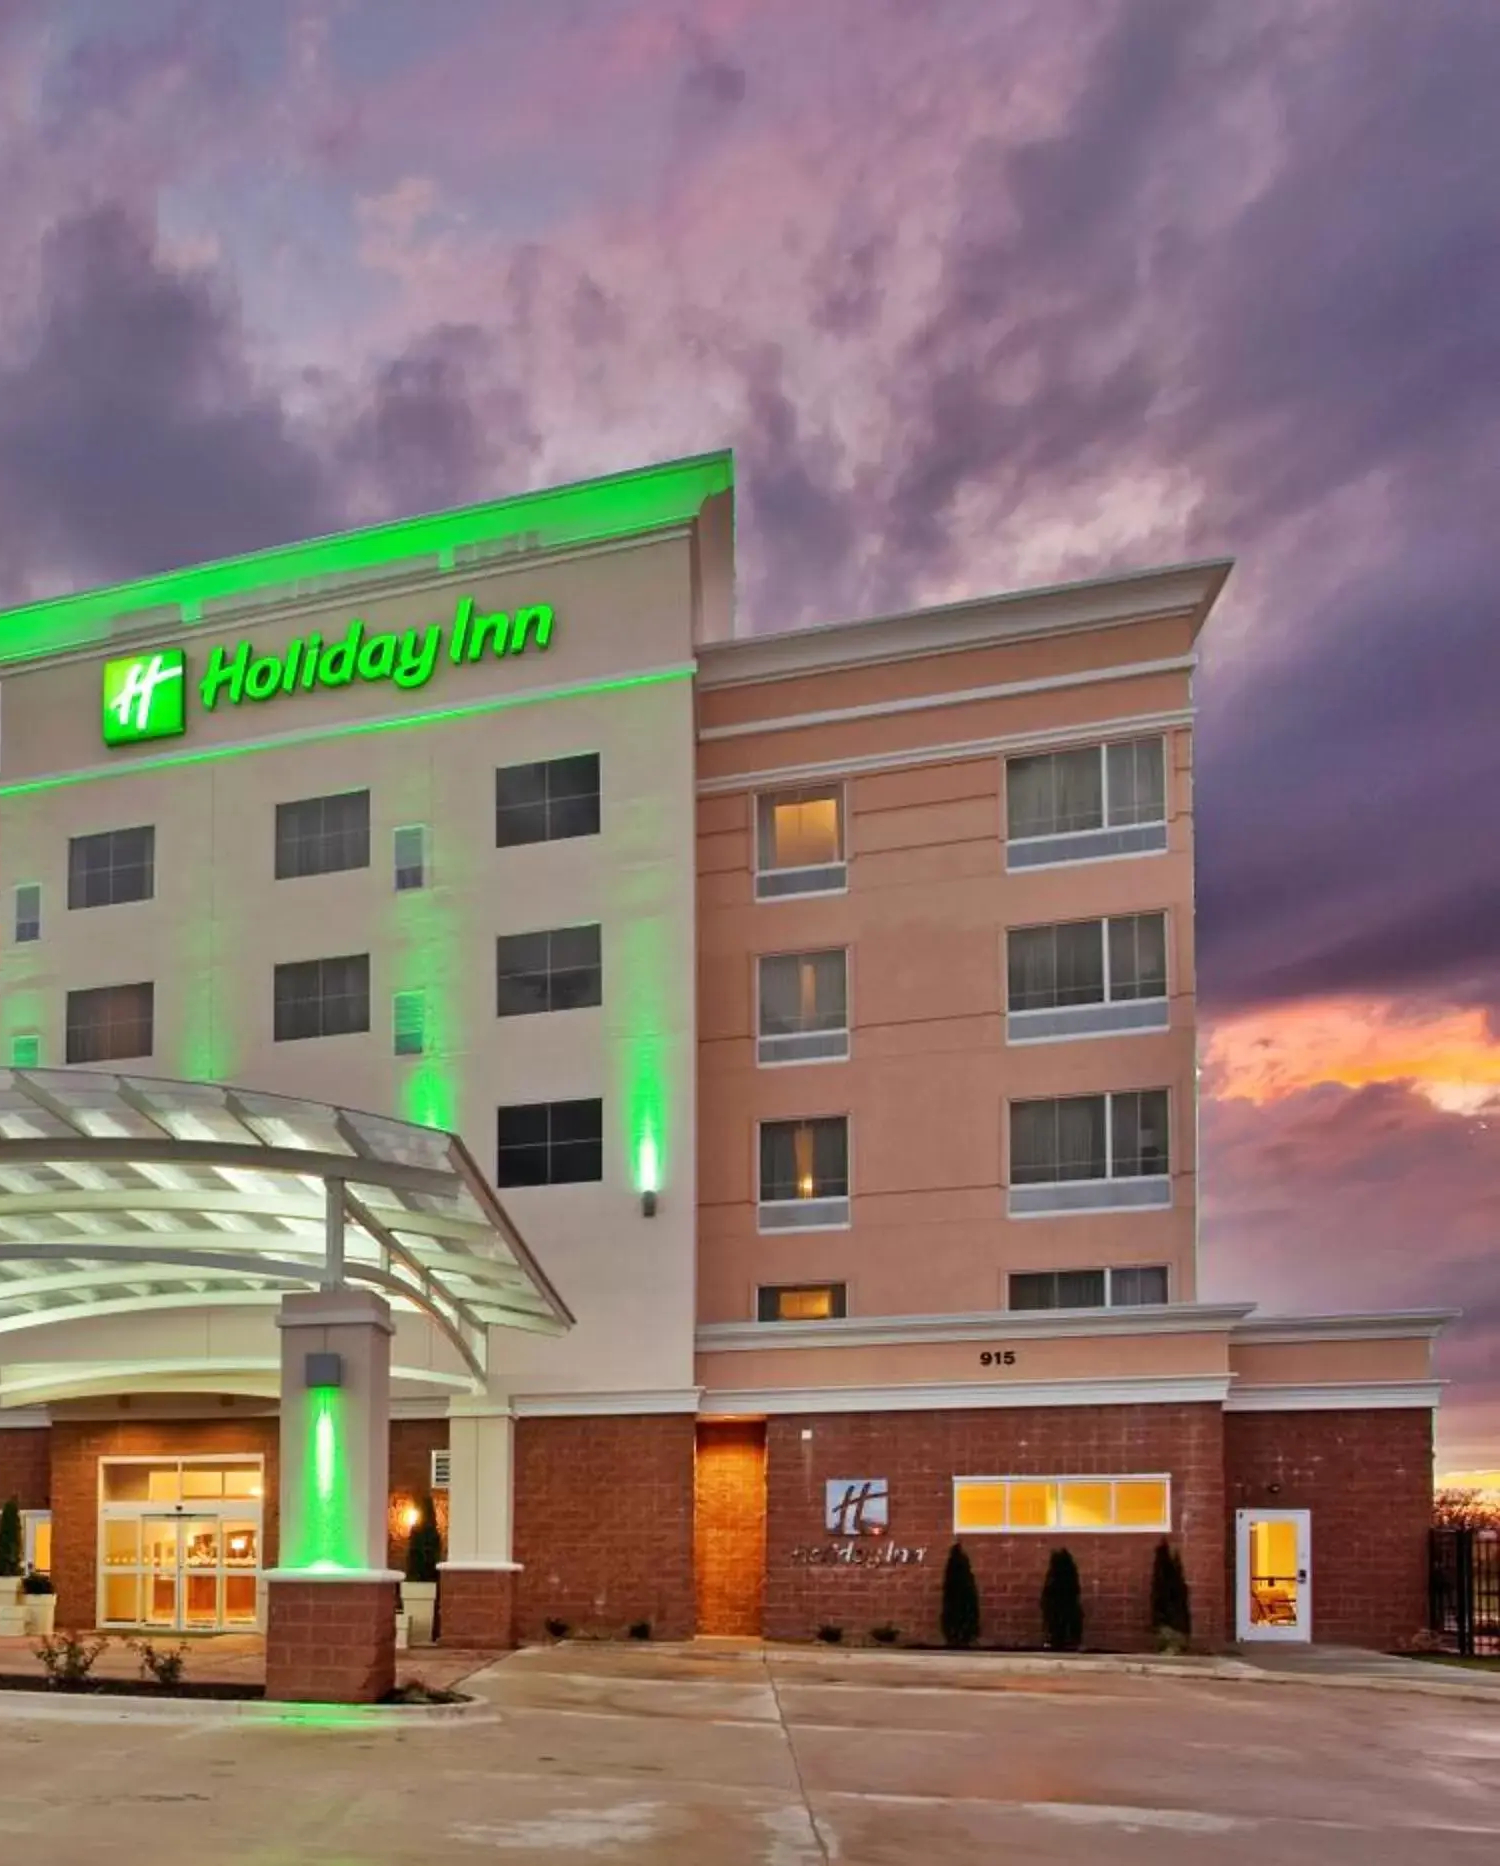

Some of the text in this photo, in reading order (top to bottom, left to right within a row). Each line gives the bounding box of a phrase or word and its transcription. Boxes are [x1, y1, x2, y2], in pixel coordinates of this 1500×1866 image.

[200, 596, 554, 712] Holiday Inn
[980, 1351, 1016, 1367] 915
